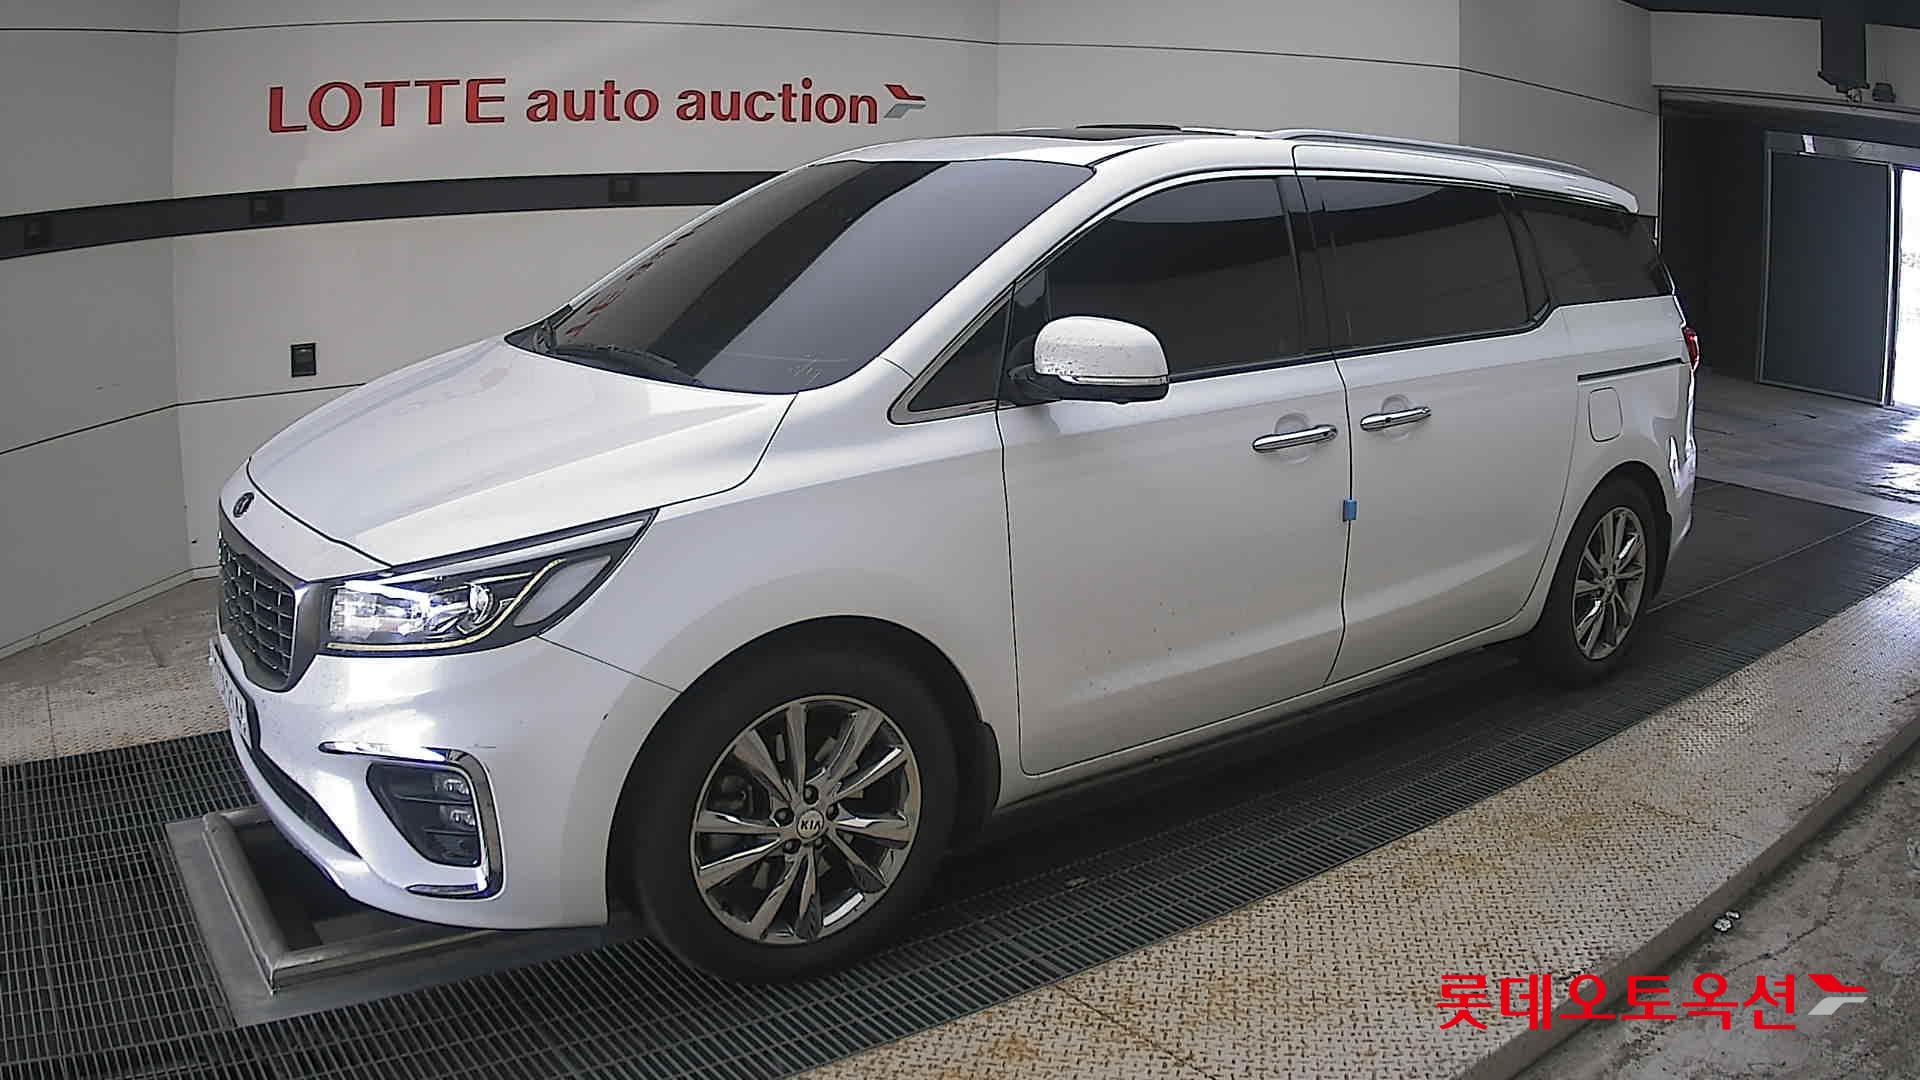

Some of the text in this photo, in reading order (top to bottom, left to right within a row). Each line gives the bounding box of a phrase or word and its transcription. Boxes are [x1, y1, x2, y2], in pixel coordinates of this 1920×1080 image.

[269, 78, 878, 132] LOTTE auto auction
[800, 819, 821, 831] KIA
